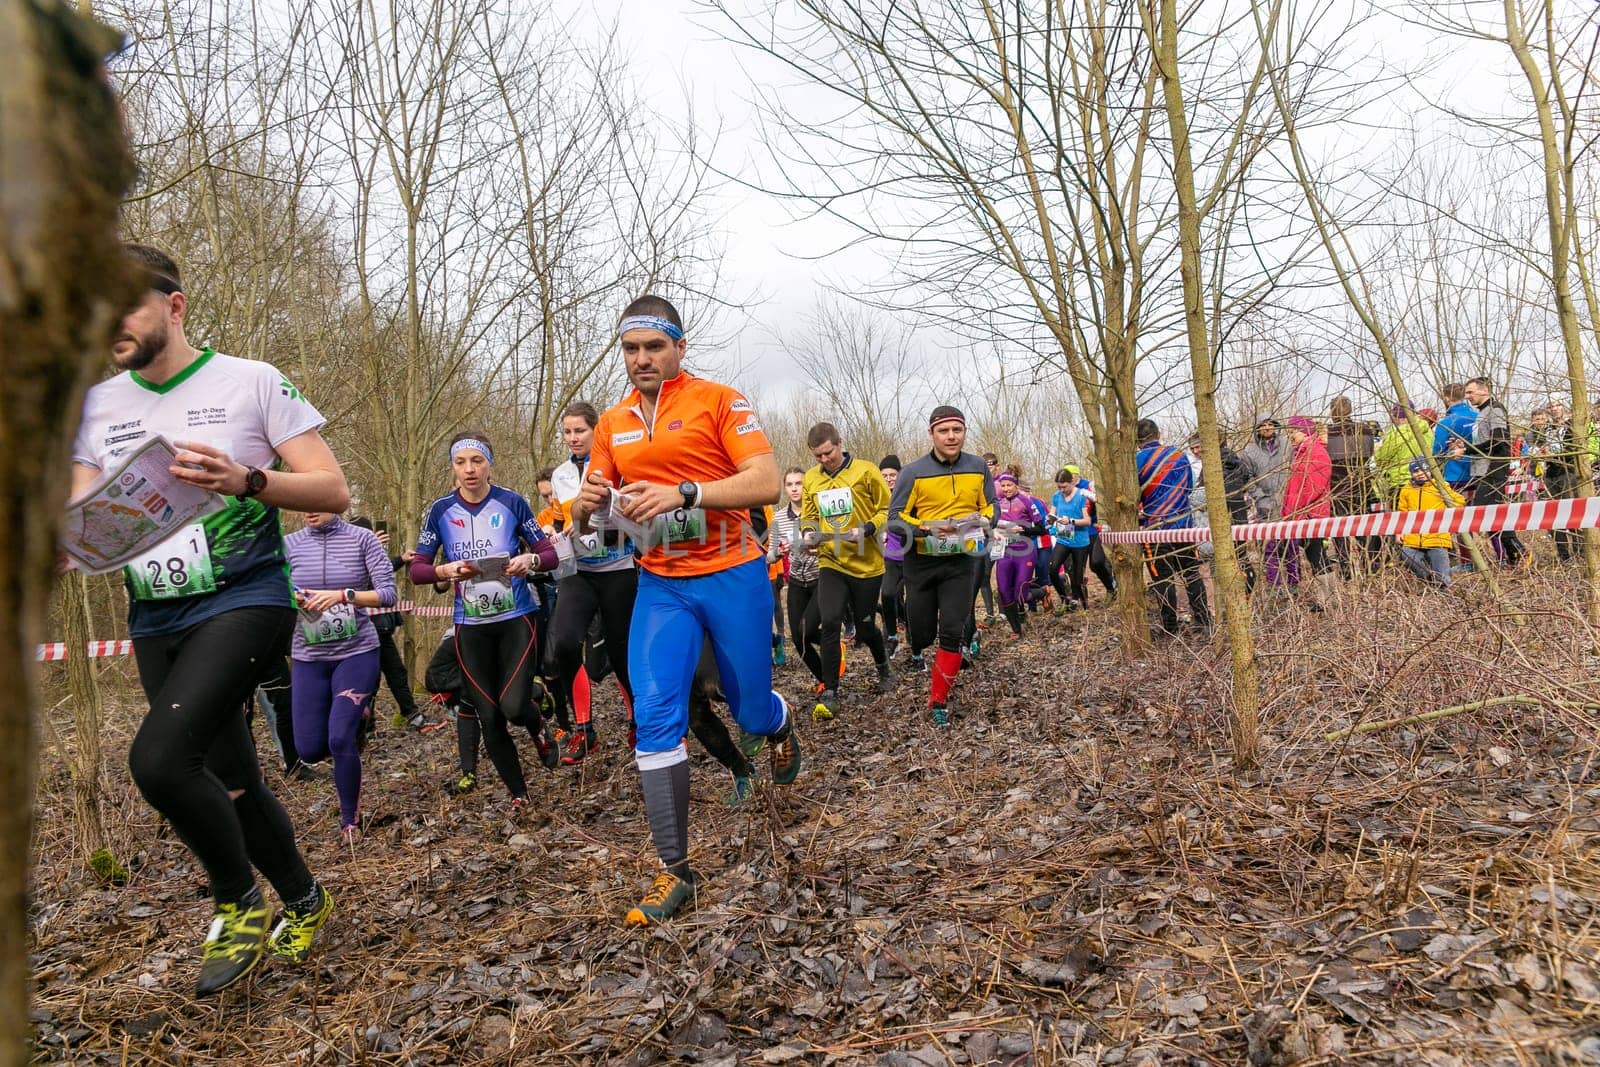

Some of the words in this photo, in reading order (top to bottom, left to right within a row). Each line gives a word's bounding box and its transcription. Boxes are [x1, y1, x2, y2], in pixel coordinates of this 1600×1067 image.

[831, 498, 845, 511] 10
[189, 538, 199, 554] 1
[448, 539, 494, 553] NEMIGA
[453, 549, 488, 560] NORD
[147, 557, 188, 588] 28
[479, 592, 503, 609] 34
[320, 618, 344, 635] 33
